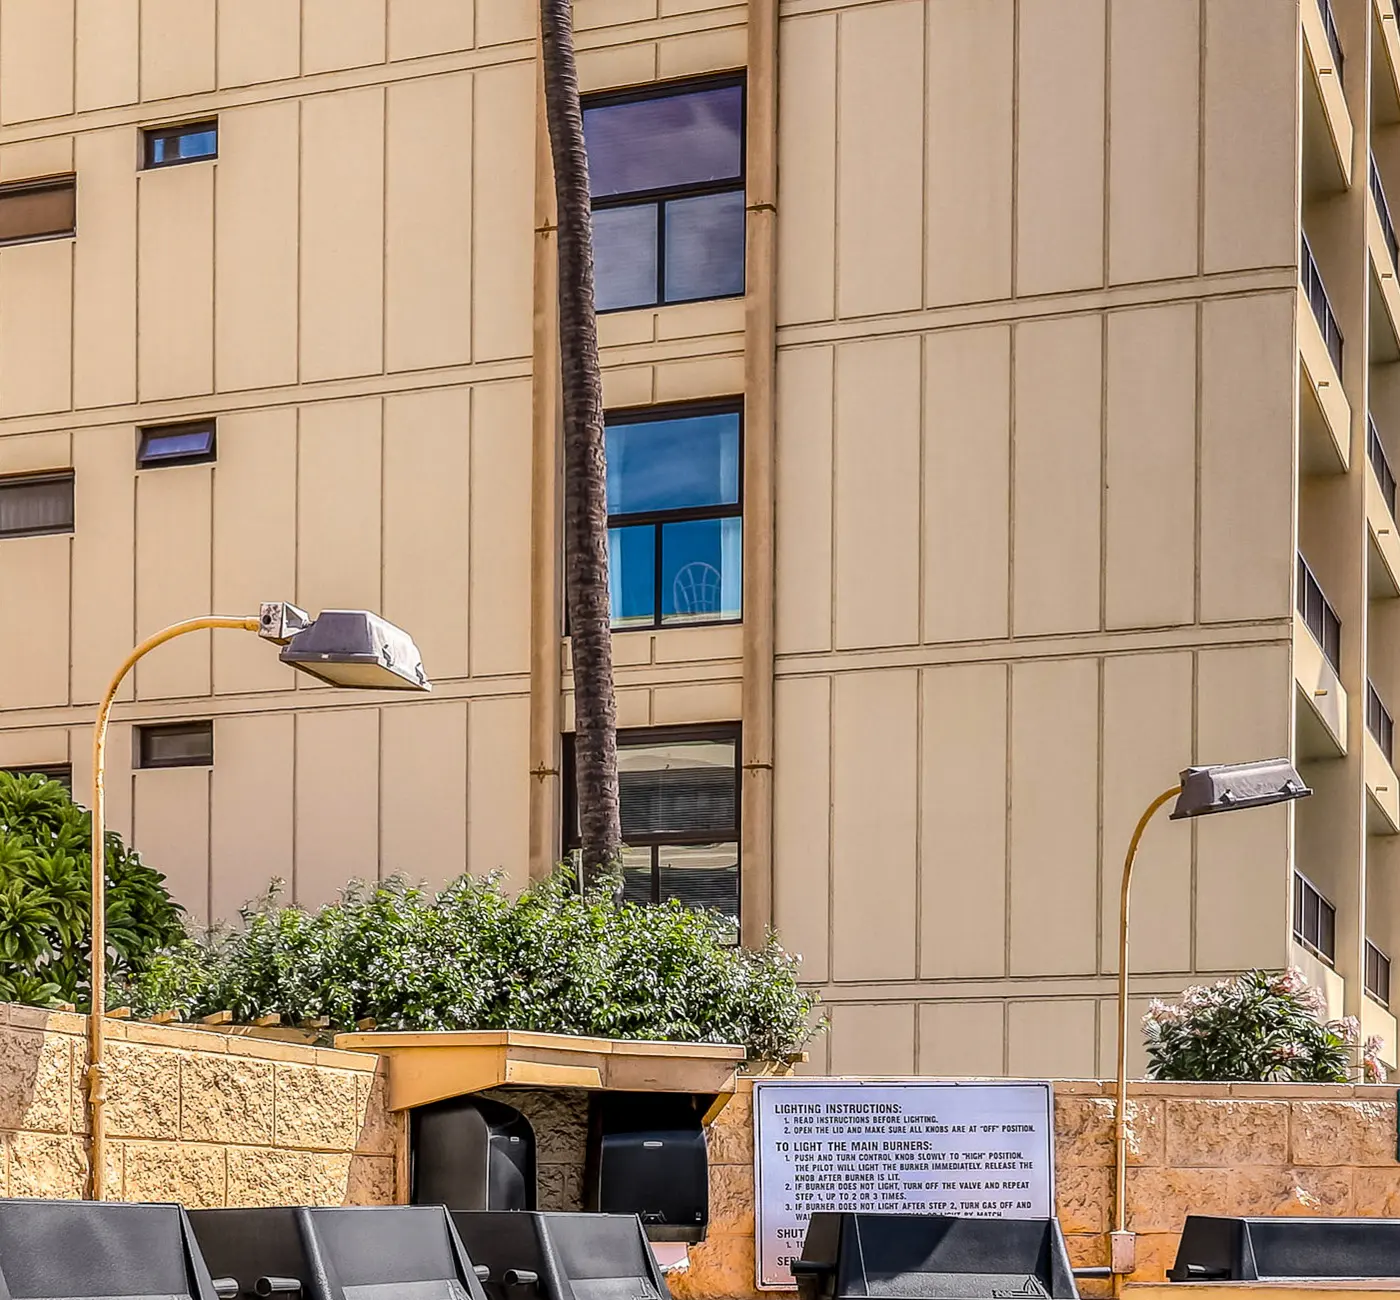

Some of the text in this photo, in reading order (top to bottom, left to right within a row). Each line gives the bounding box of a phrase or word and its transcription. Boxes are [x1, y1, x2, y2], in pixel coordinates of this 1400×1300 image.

[774, 1103, 902, 1114] LIGHTING INSTRUCTIONS:
[817, 1116, 870, 1124] INSTRUCTIONS
[873, 1116, 900, 1124] BEFORE
[904, 1116, 939, 1124] LIGHTING.
[793, 1126, 814, 1134] OPEN
[816, 1126, 829, 1134] THE
[833, 1126, 844, 1134] LID
[847, 1126, 862, 1134] AND
[865, 1126, 885, 1134] MAKE
[888, 1126, 906, 1134] SURE
[909, 1126, 922, 1134] ALL
[925, 1125, 949, 1133] KNOBS
[952, 1125, 966, 1133] ARE
[969, 1125, 977, 1133] AT
[1002, 1125, 1036, 1133] POSITION.
[775, 1141, 933, 1152] TO LIGHT THE MAIN BURNERS:
[785, 1154, 790, 1162] 1.
[794, 1153, 814, 1162] PUSH
[817, 1153, 833, 1162] AND
[836, 1153, 856, 1161] TURN
[858, 1153, 892, 1161] CONTROL
[894, 1153, 915, 1161] KNOB
[917, 1153, 946, 1161] SLOWLY
[950, 1152, 960, 1161] TO
[988, 1152, 1024, 1160] POSITION.
[795, 1163, 809, 1172] THE
[812, 1163, 834, 1171] PILOT
[837, 1163, 855, 1171] WILL
[858, 1163, 879, 1171] LIGHT
[882, 1163, 897, 1171] THE
[900, 1162, 929, 1171] BURNER
[984, 1162, 1016, 1170] RELEASE
[1019, 1161, 1033, 1170] THE
[794, 1174, 815, 1182] KNOB
[818, 1174, 842, 1182] AFTER
[785, 1183, 792, 1191] 2.
[795, 1183, 802, 1191] IF
[805, 1183, 835, 1191] BURNER
[860, 1182, 874, 1190] NOT
[878, 1182, 900, 1191] LIGHT,
[903, 1182, 923, 1190] TURN
[925, 1182, 939, 1190] OFF
[942, 1182, 956, 1190] THE
[959, 1182, 982, 1190] VALVE
[1002, 1181, 1030, 1189] REPEAT
[795, 1193, 814, 1201] STEP
[785, 1203, 792, 1211] 3.
[795, 1203, 802, 1211] IF
[878, 1202, 899, 1210] LIGHT
[902, 1202, 926, 1210] AFTER
[928, 1202, 947, 1210] STEP
[960, 1202, 980, 1210] TURN
[999, 1201, 1013, 1209] OFF
[1016, 1201, 1032, 1209] AND
[776, 1228, 805, 1238] SHUT
